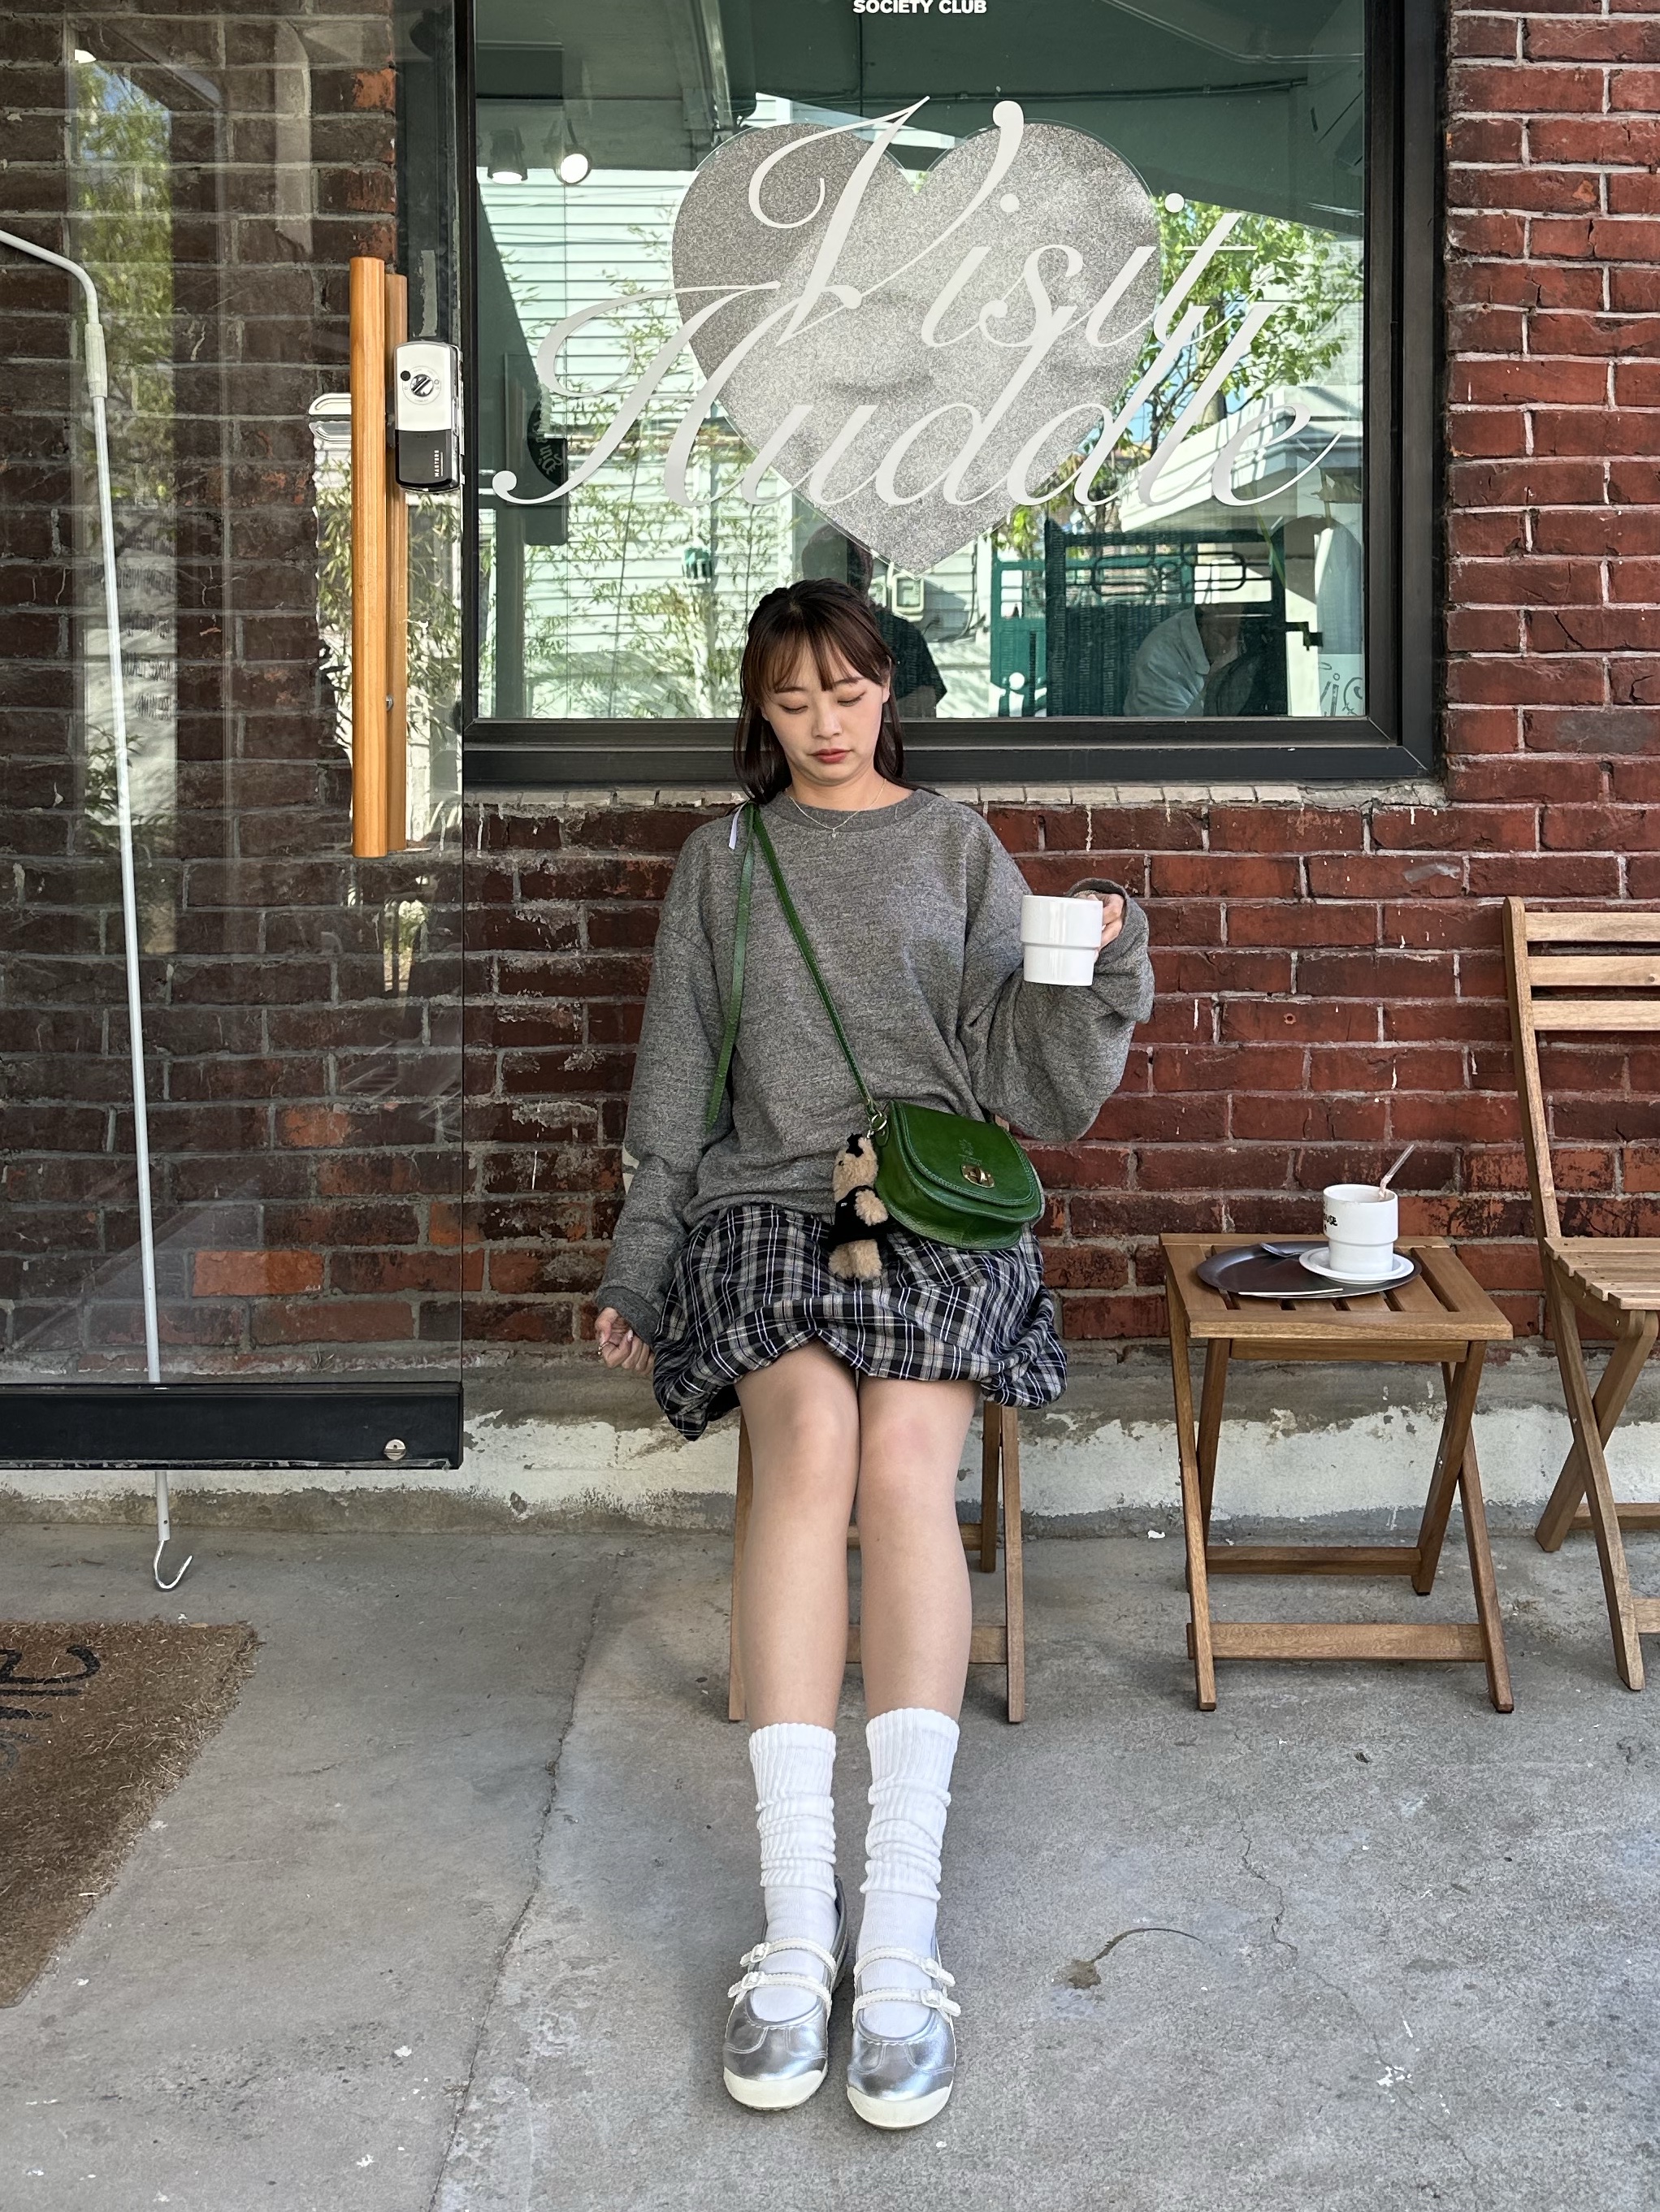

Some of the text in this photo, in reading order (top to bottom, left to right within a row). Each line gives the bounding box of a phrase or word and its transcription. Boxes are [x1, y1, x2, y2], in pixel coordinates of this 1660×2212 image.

[852, 0, 987, 13] SOCIETY CLUB
[748, 95, 1264, 348] Visit
[492, 279, 1346, 509] Huddle
